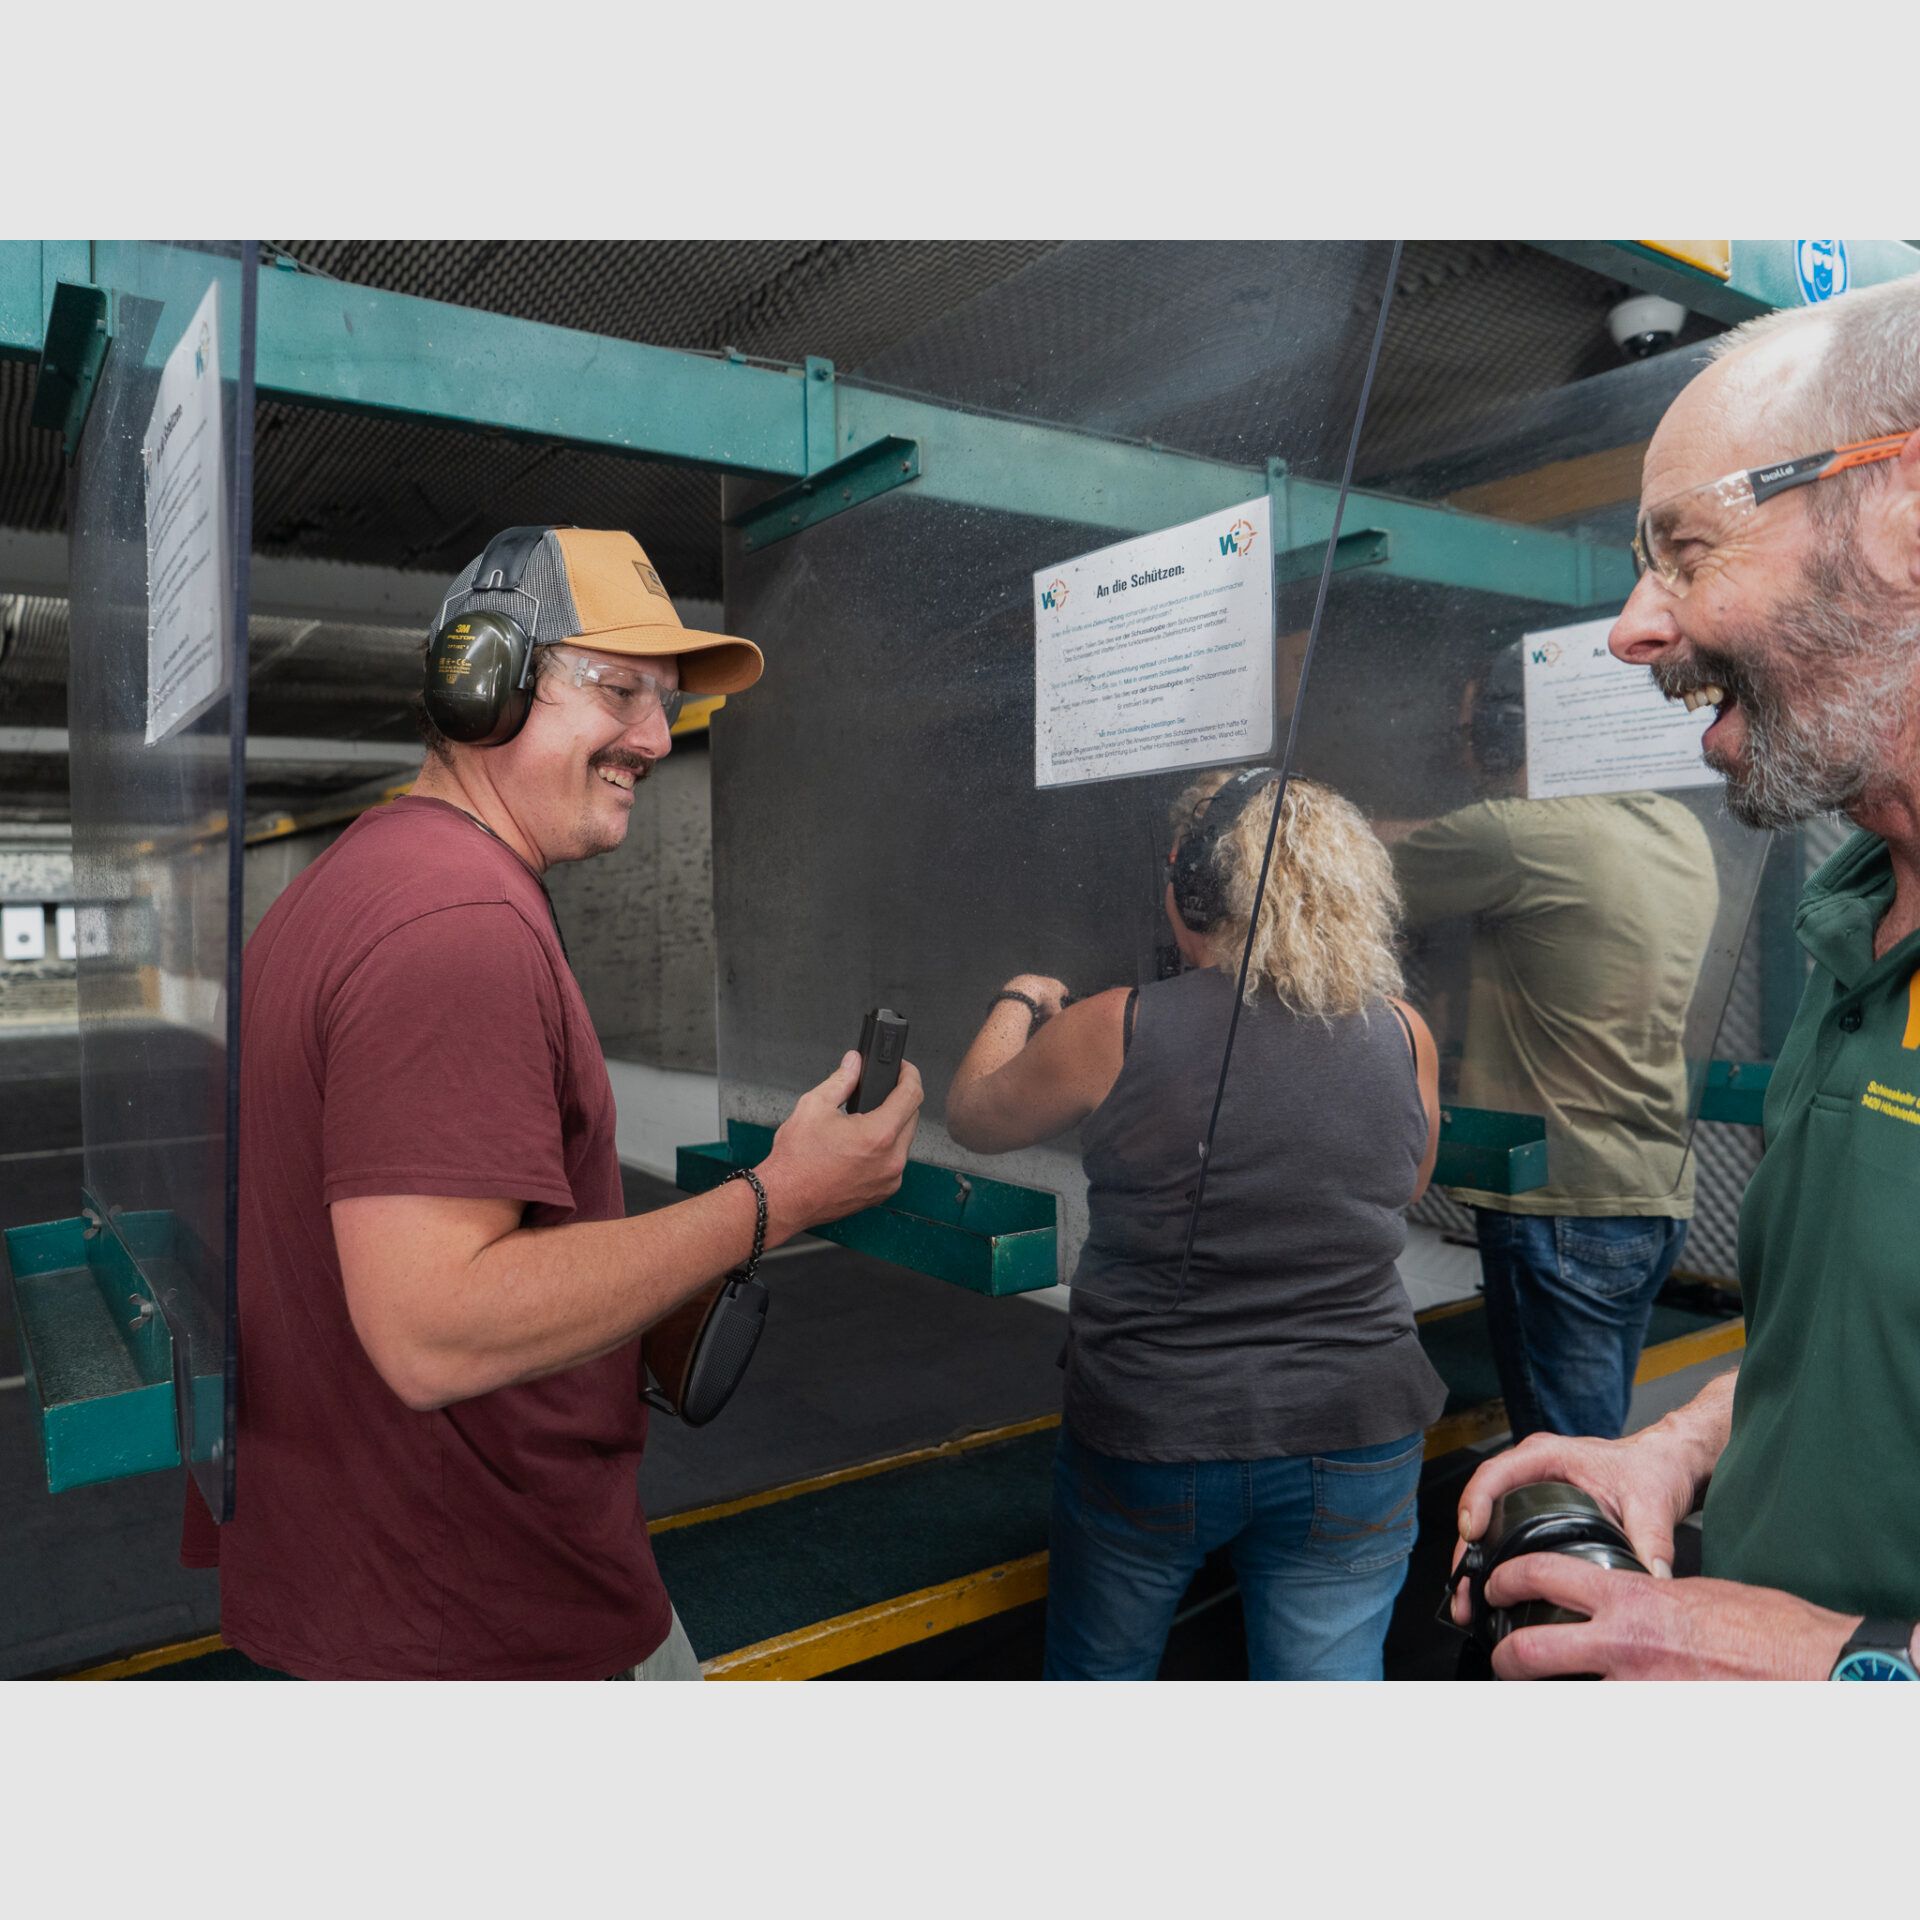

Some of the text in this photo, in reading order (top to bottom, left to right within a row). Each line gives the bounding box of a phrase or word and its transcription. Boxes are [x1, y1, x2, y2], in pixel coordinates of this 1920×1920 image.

[1097, 564, 1185, 599] An die Schützen:
[455, 623, 472, 634] 3M
[1592, 648, 1606, 658] An
